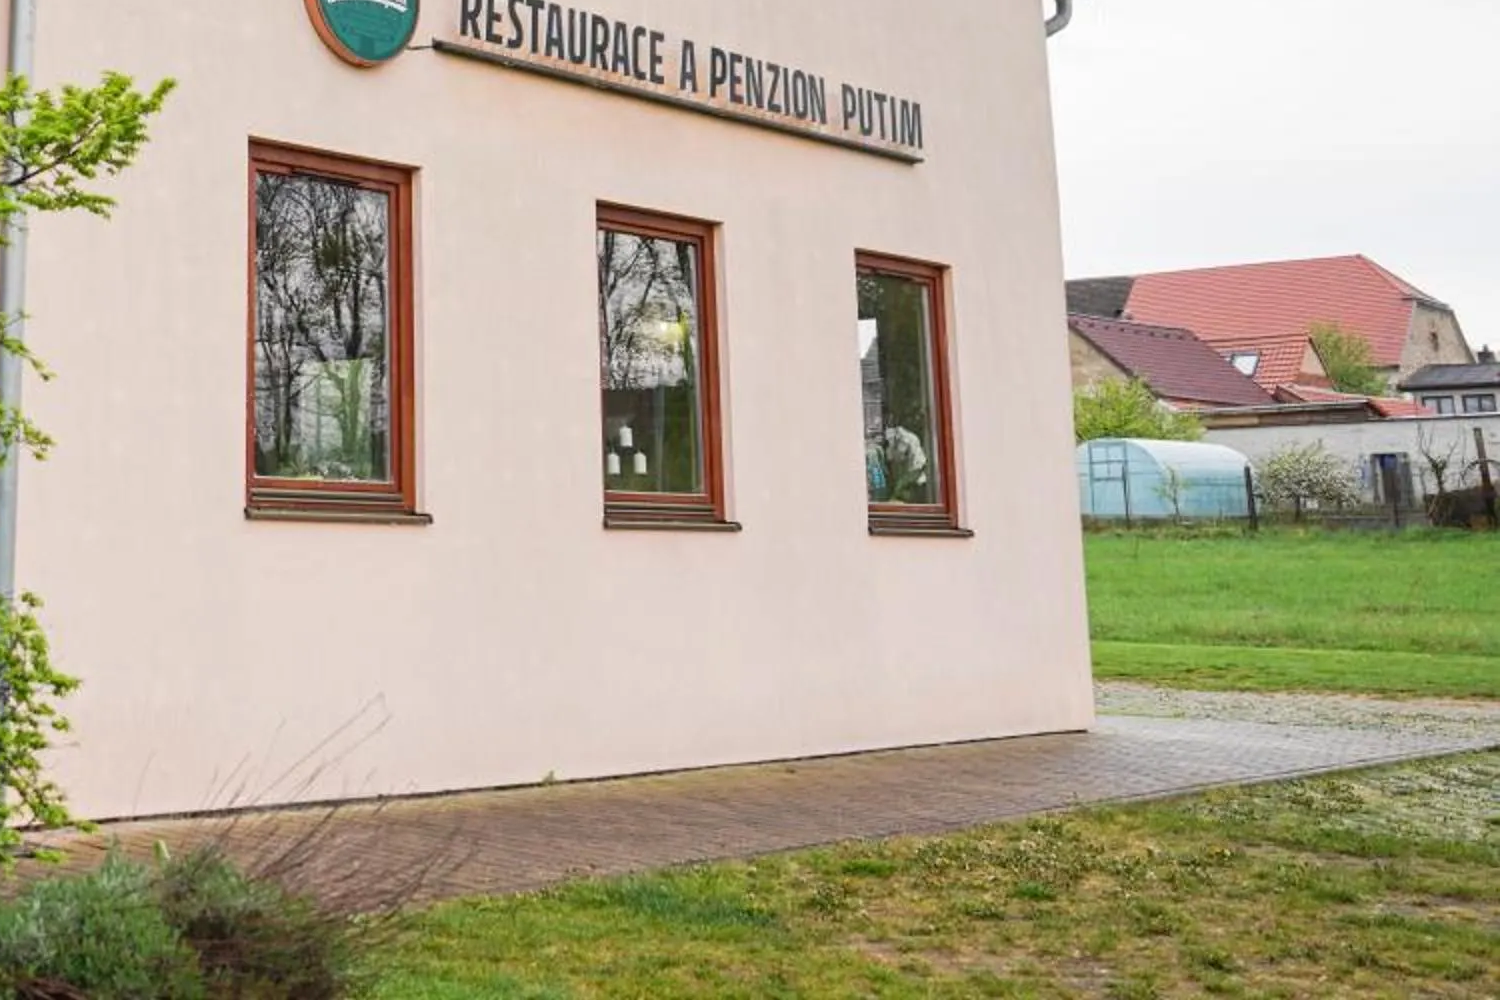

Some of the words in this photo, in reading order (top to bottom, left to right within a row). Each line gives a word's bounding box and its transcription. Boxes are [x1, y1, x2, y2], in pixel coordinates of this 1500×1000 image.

[679, 39, 699, 93] A
[709, 46, 827, 125] PENZION
[840, 83, 924, 150] PUTIM
